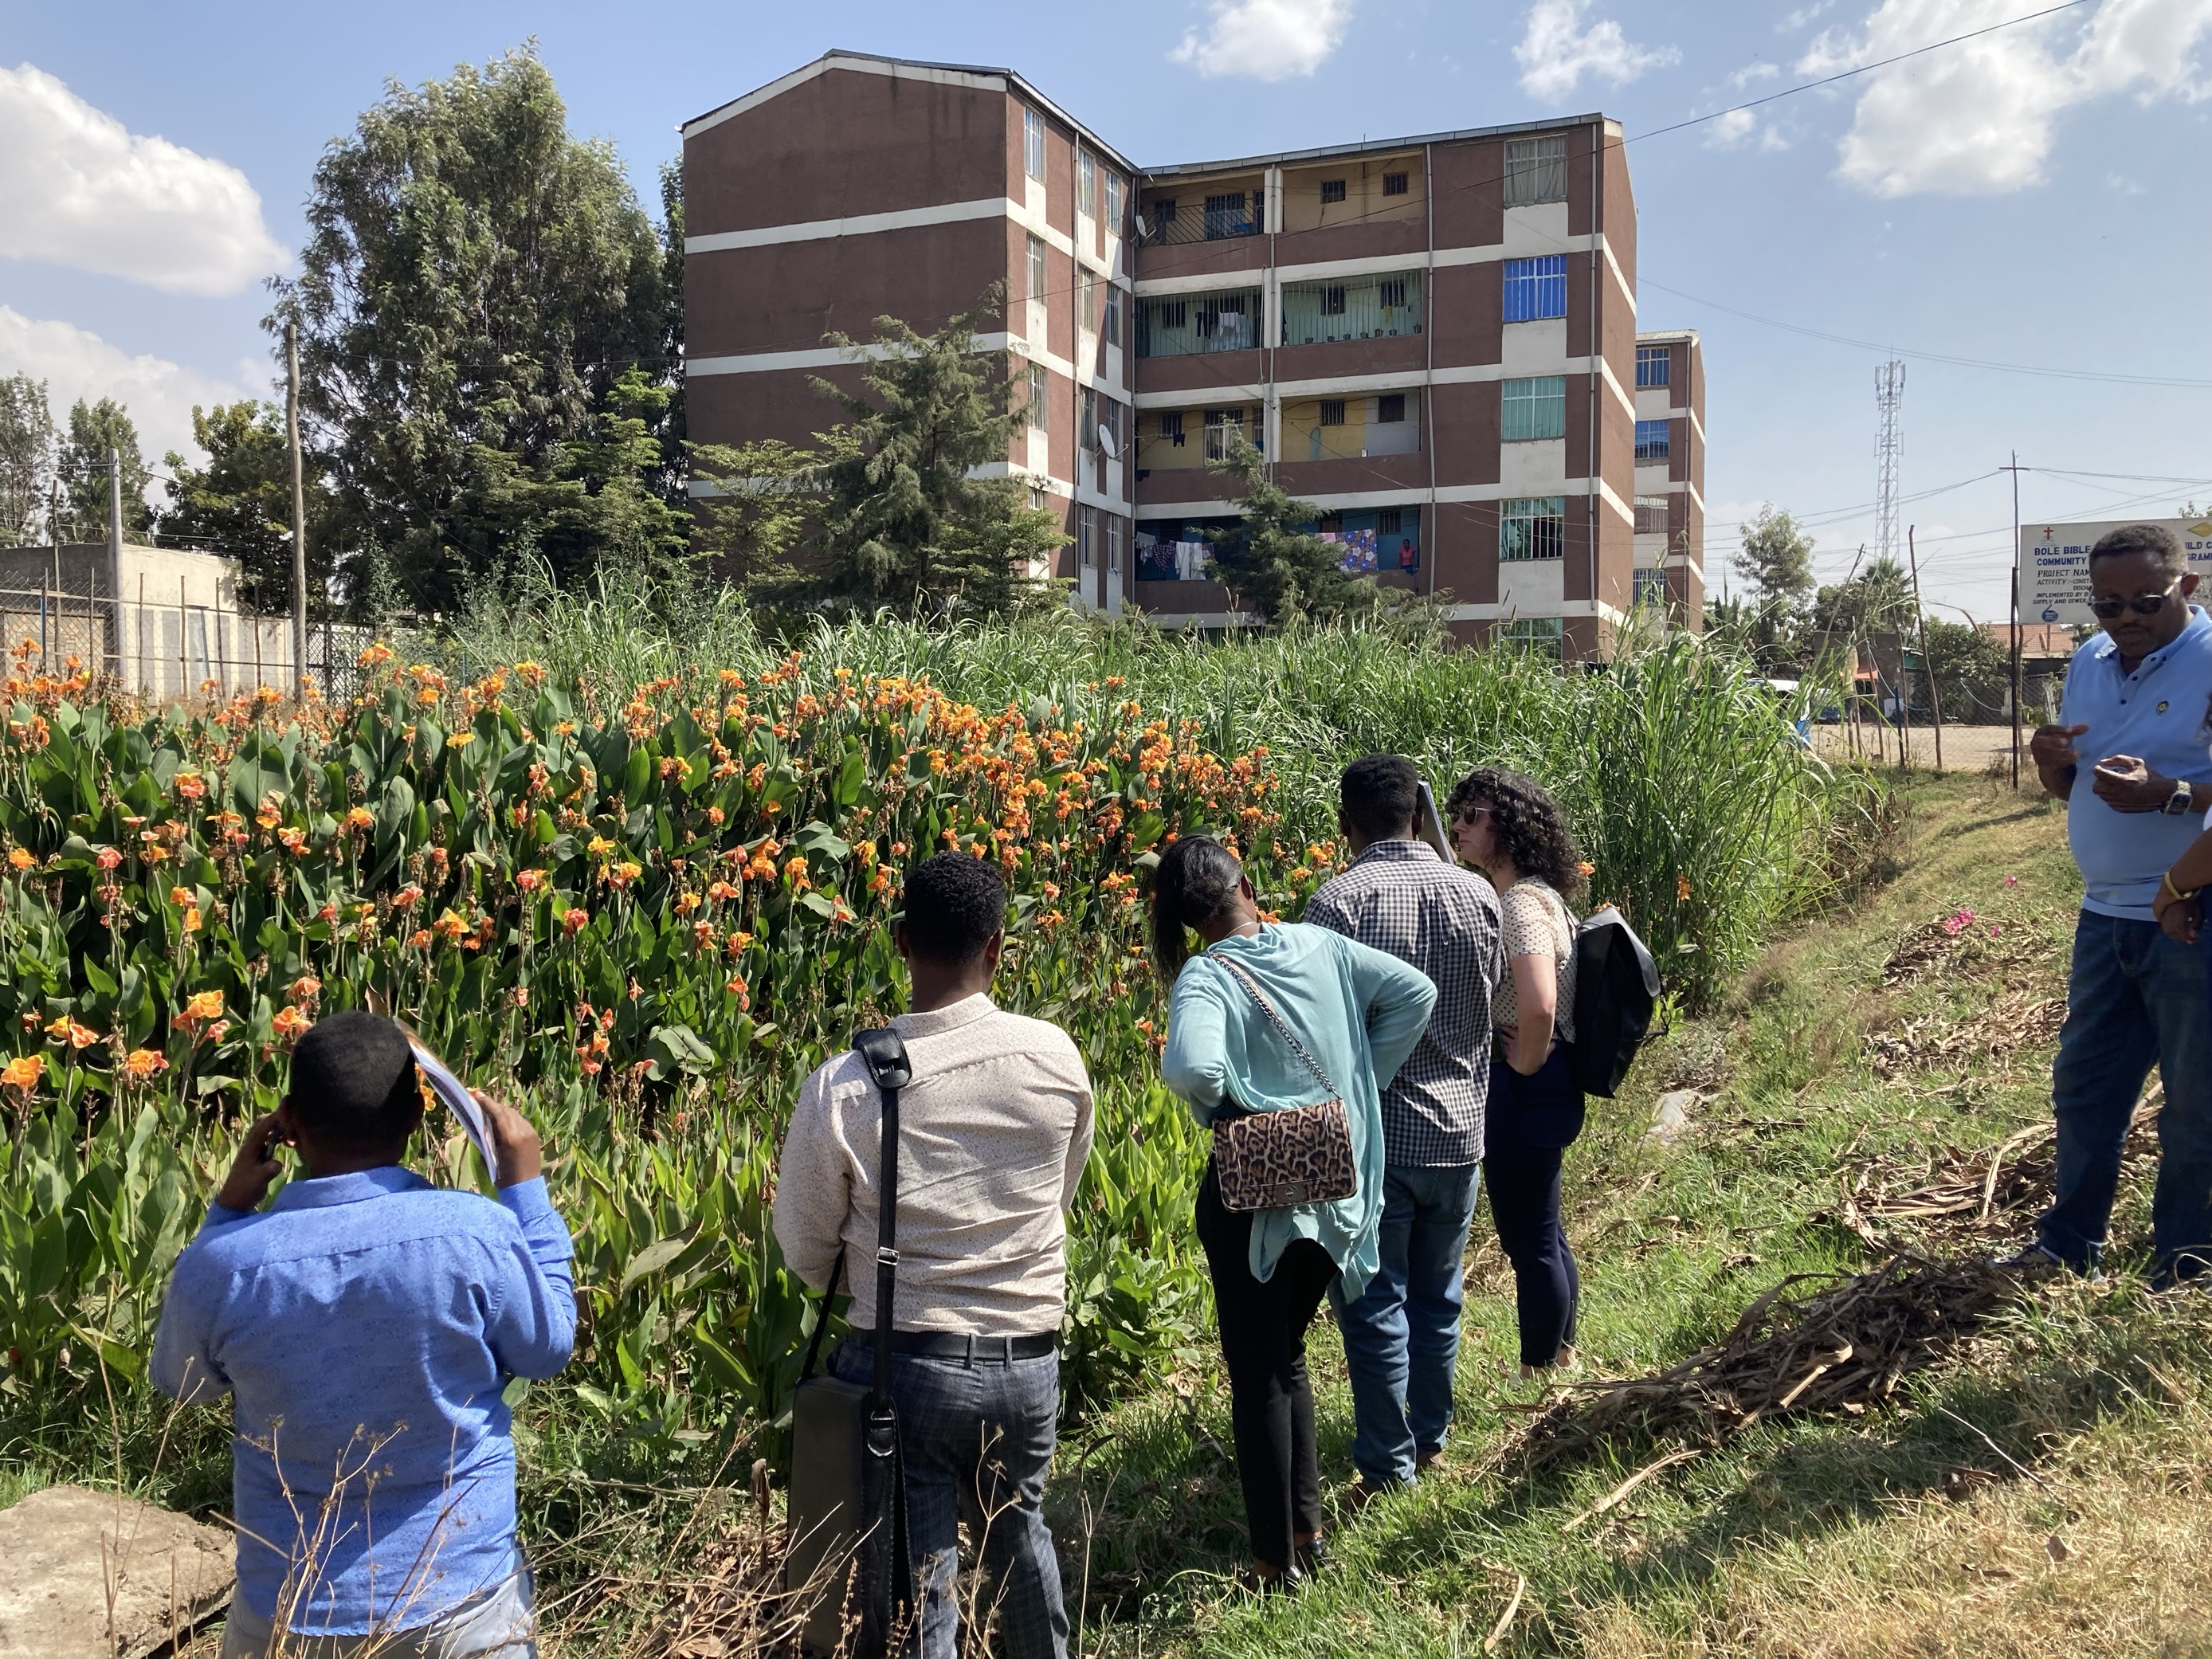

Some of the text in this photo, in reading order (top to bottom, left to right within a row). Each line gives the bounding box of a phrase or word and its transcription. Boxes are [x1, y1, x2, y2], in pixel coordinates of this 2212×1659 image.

[2034, 547, 2060, 555] BOLE
[2063, 546, 2092, 555] BIBLE
[2037, 557, 2087, 566] COMMUNITY
[2037, 569, 2070, 578] PROJECT
